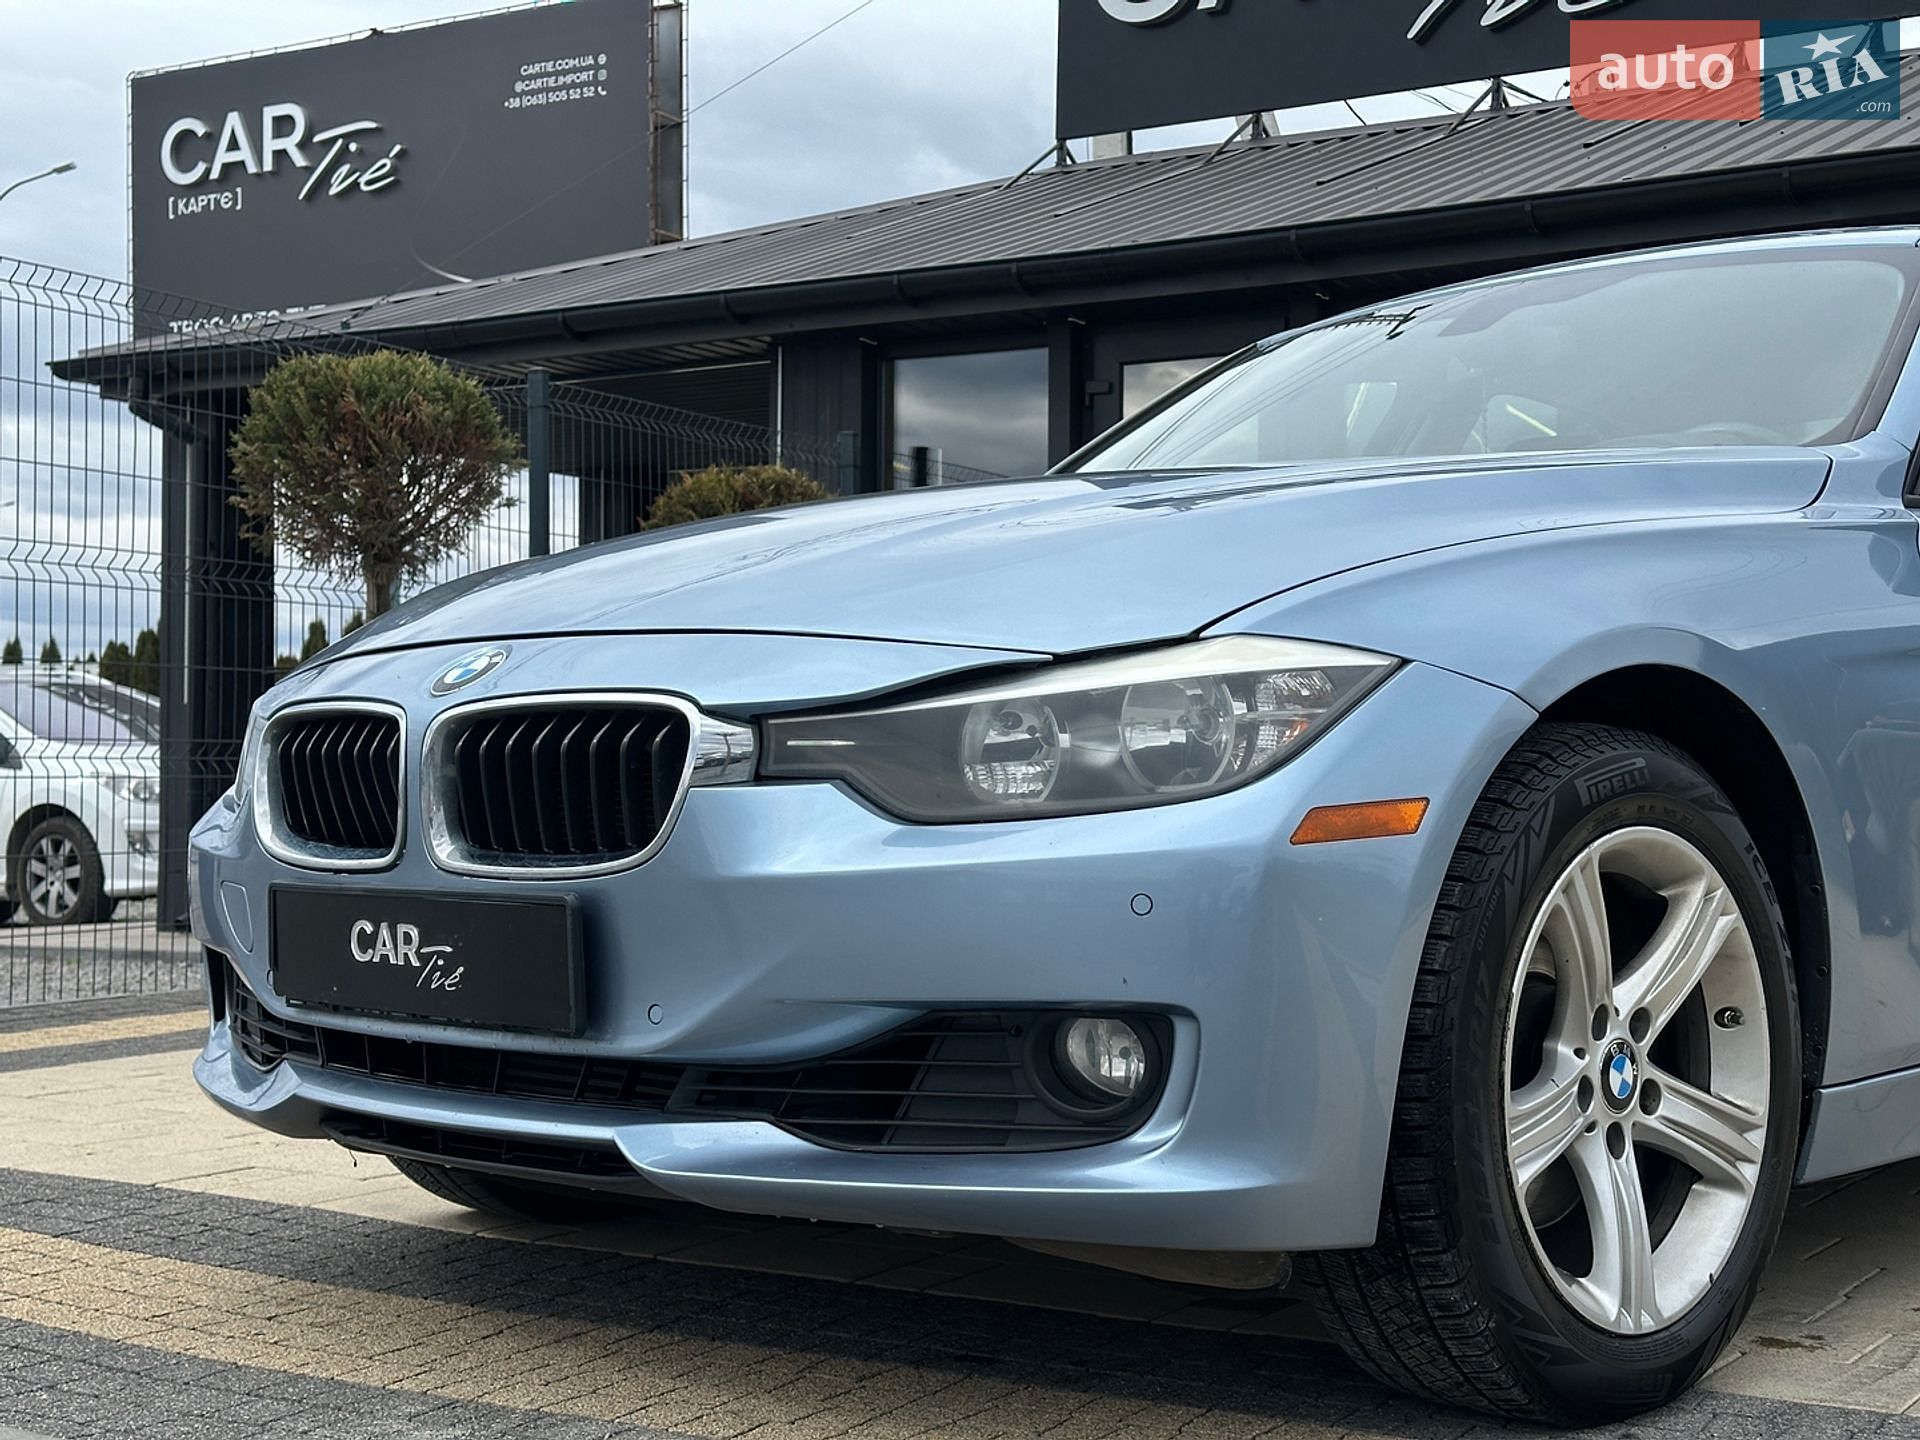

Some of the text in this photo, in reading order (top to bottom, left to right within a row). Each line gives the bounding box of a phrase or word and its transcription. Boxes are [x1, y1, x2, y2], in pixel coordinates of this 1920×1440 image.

[160, 102, 312, 186] CAR
[1575, 757, 1650, 808] PIRELLI
[350, 919, 422, 967] CAR
